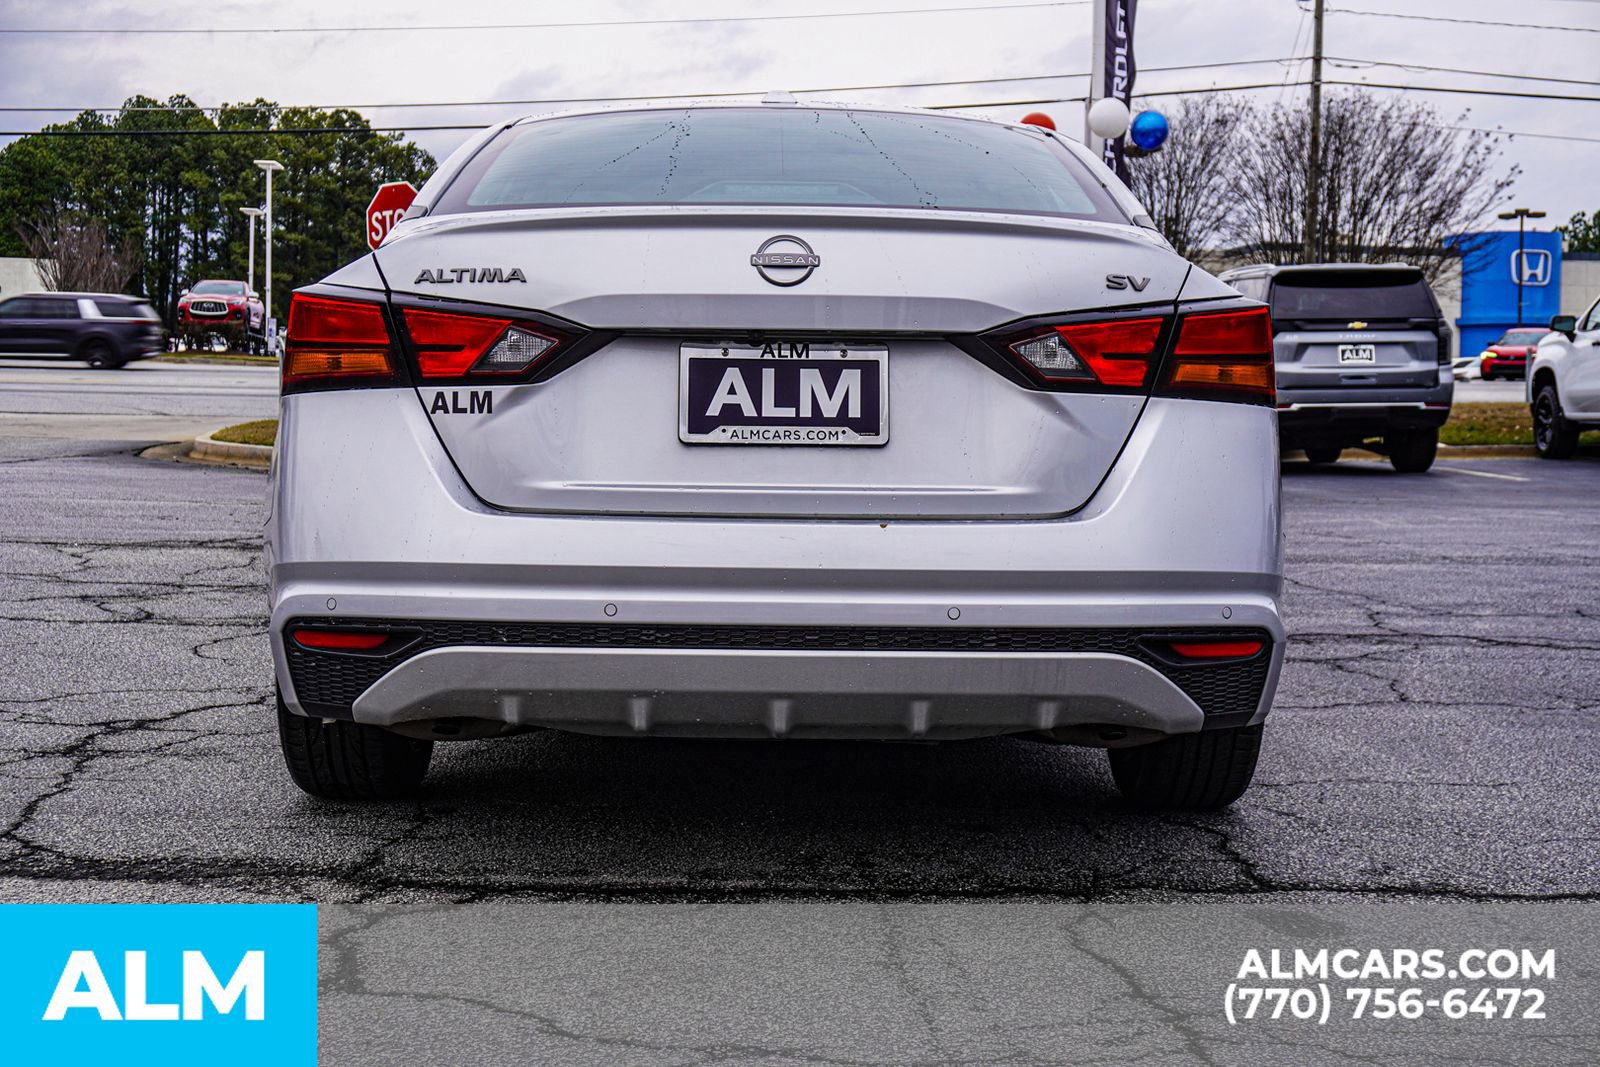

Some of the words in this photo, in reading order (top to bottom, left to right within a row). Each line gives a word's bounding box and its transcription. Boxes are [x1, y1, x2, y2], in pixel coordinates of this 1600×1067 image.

[752, 254, 819, 265] NISSAN
[414, 268, 527, 285] ALTIMA
[1106, 274, 1151, 292] SV
[760, 343, 810, 358] ALM
[1343, 350, 1371, 360] ALM
[705, 367, 861, 418] ALM
[430, 391, 493, 414] ALM
[729, 429, 840, 441] ALMCARS.COM
